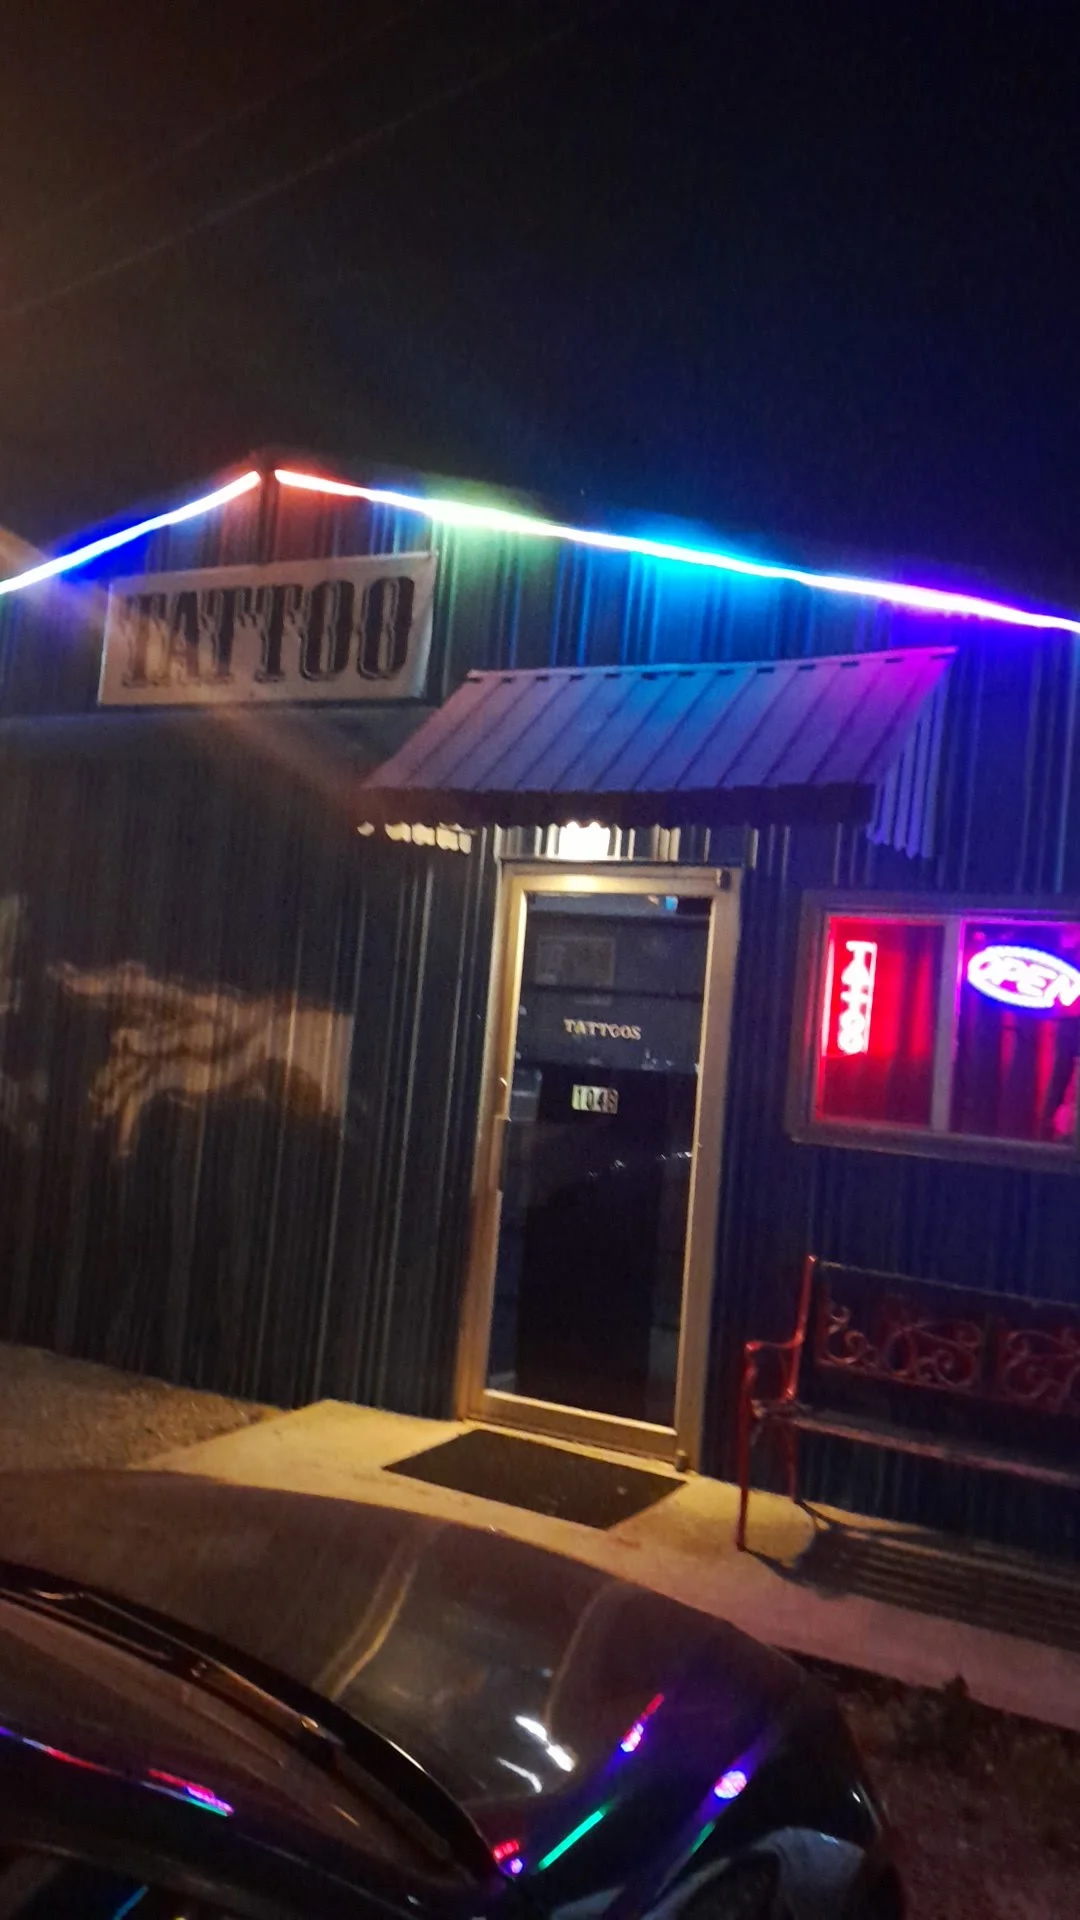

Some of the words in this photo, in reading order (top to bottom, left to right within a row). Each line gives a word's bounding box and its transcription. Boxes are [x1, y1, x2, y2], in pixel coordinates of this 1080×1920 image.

[118, 576, 415, 687] TATTOO
[967, 945, 1080, 1007] OPEN
[563, 1018, 641, 1040] TATTOOS
